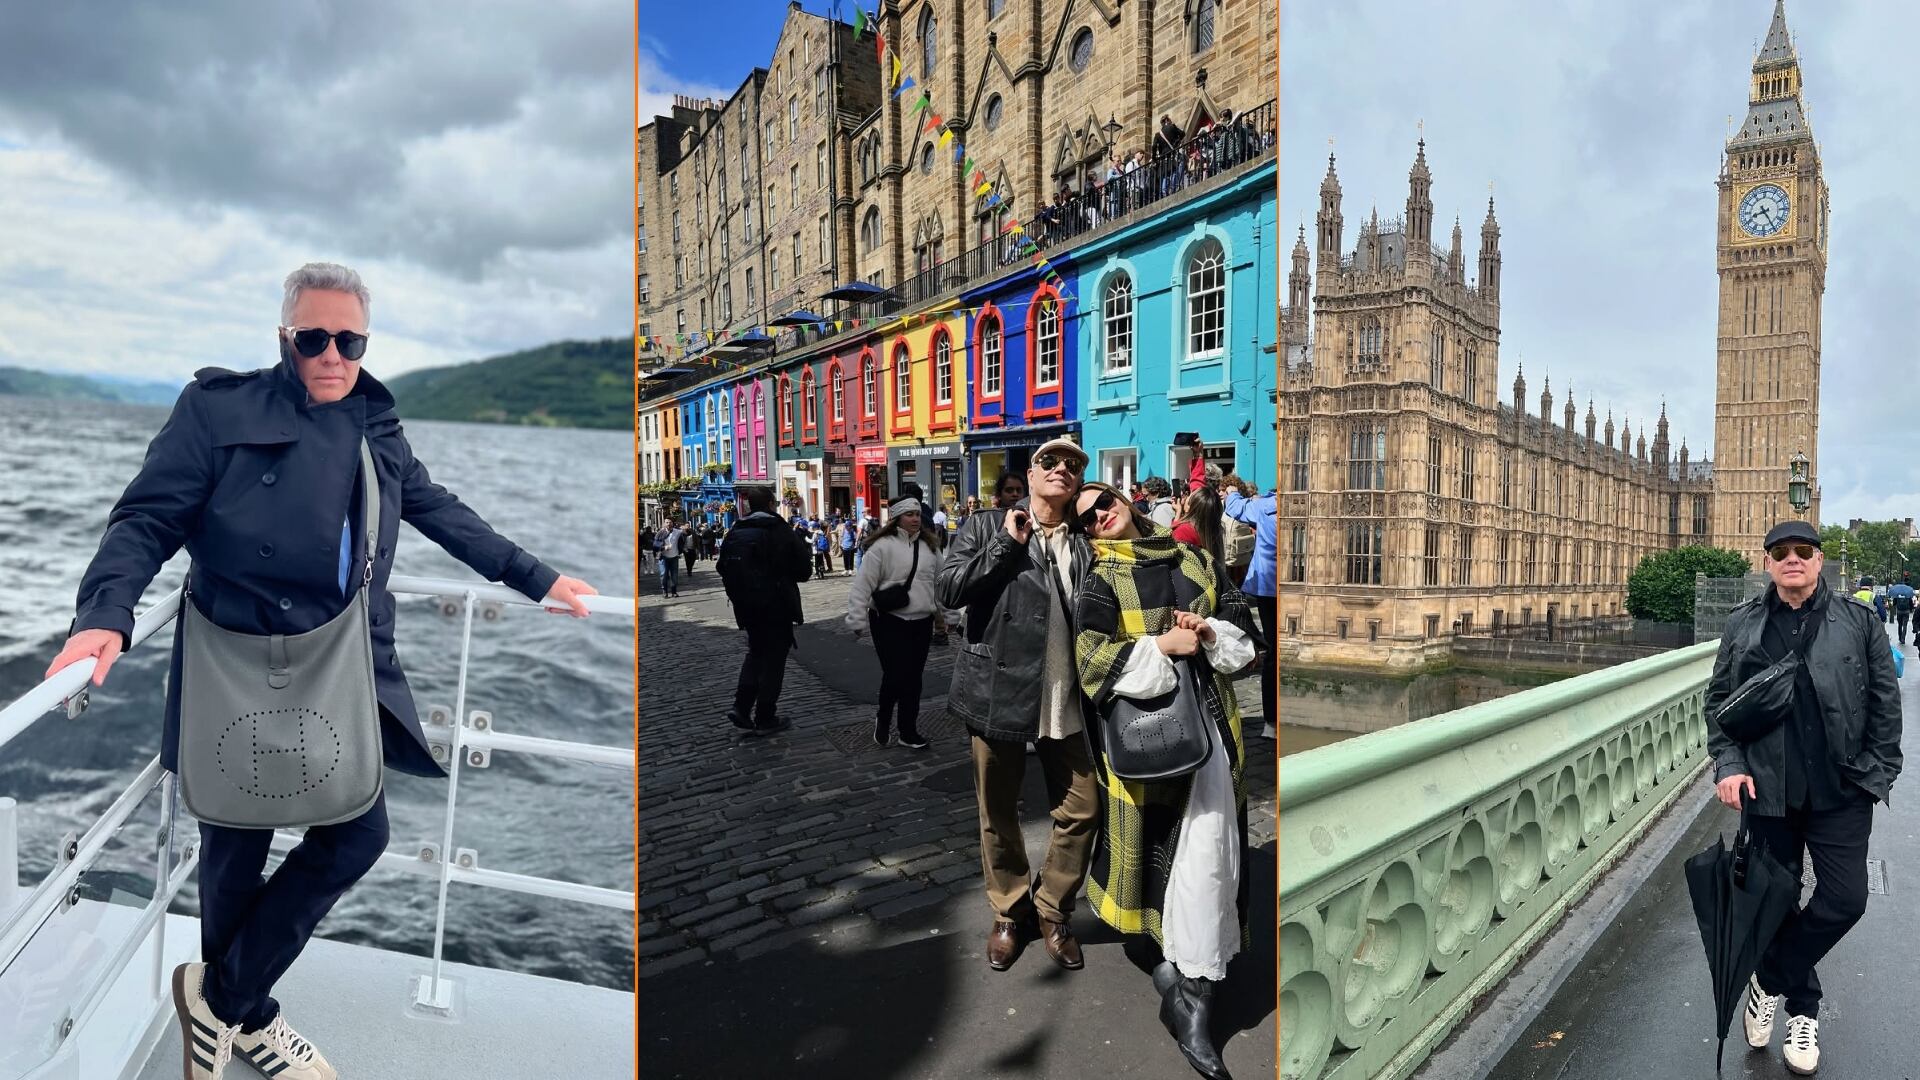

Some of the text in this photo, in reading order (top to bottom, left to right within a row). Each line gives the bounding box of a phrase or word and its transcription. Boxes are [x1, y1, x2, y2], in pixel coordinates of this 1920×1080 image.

[899, 446, 950, 458] THE WHISKY SHOP
